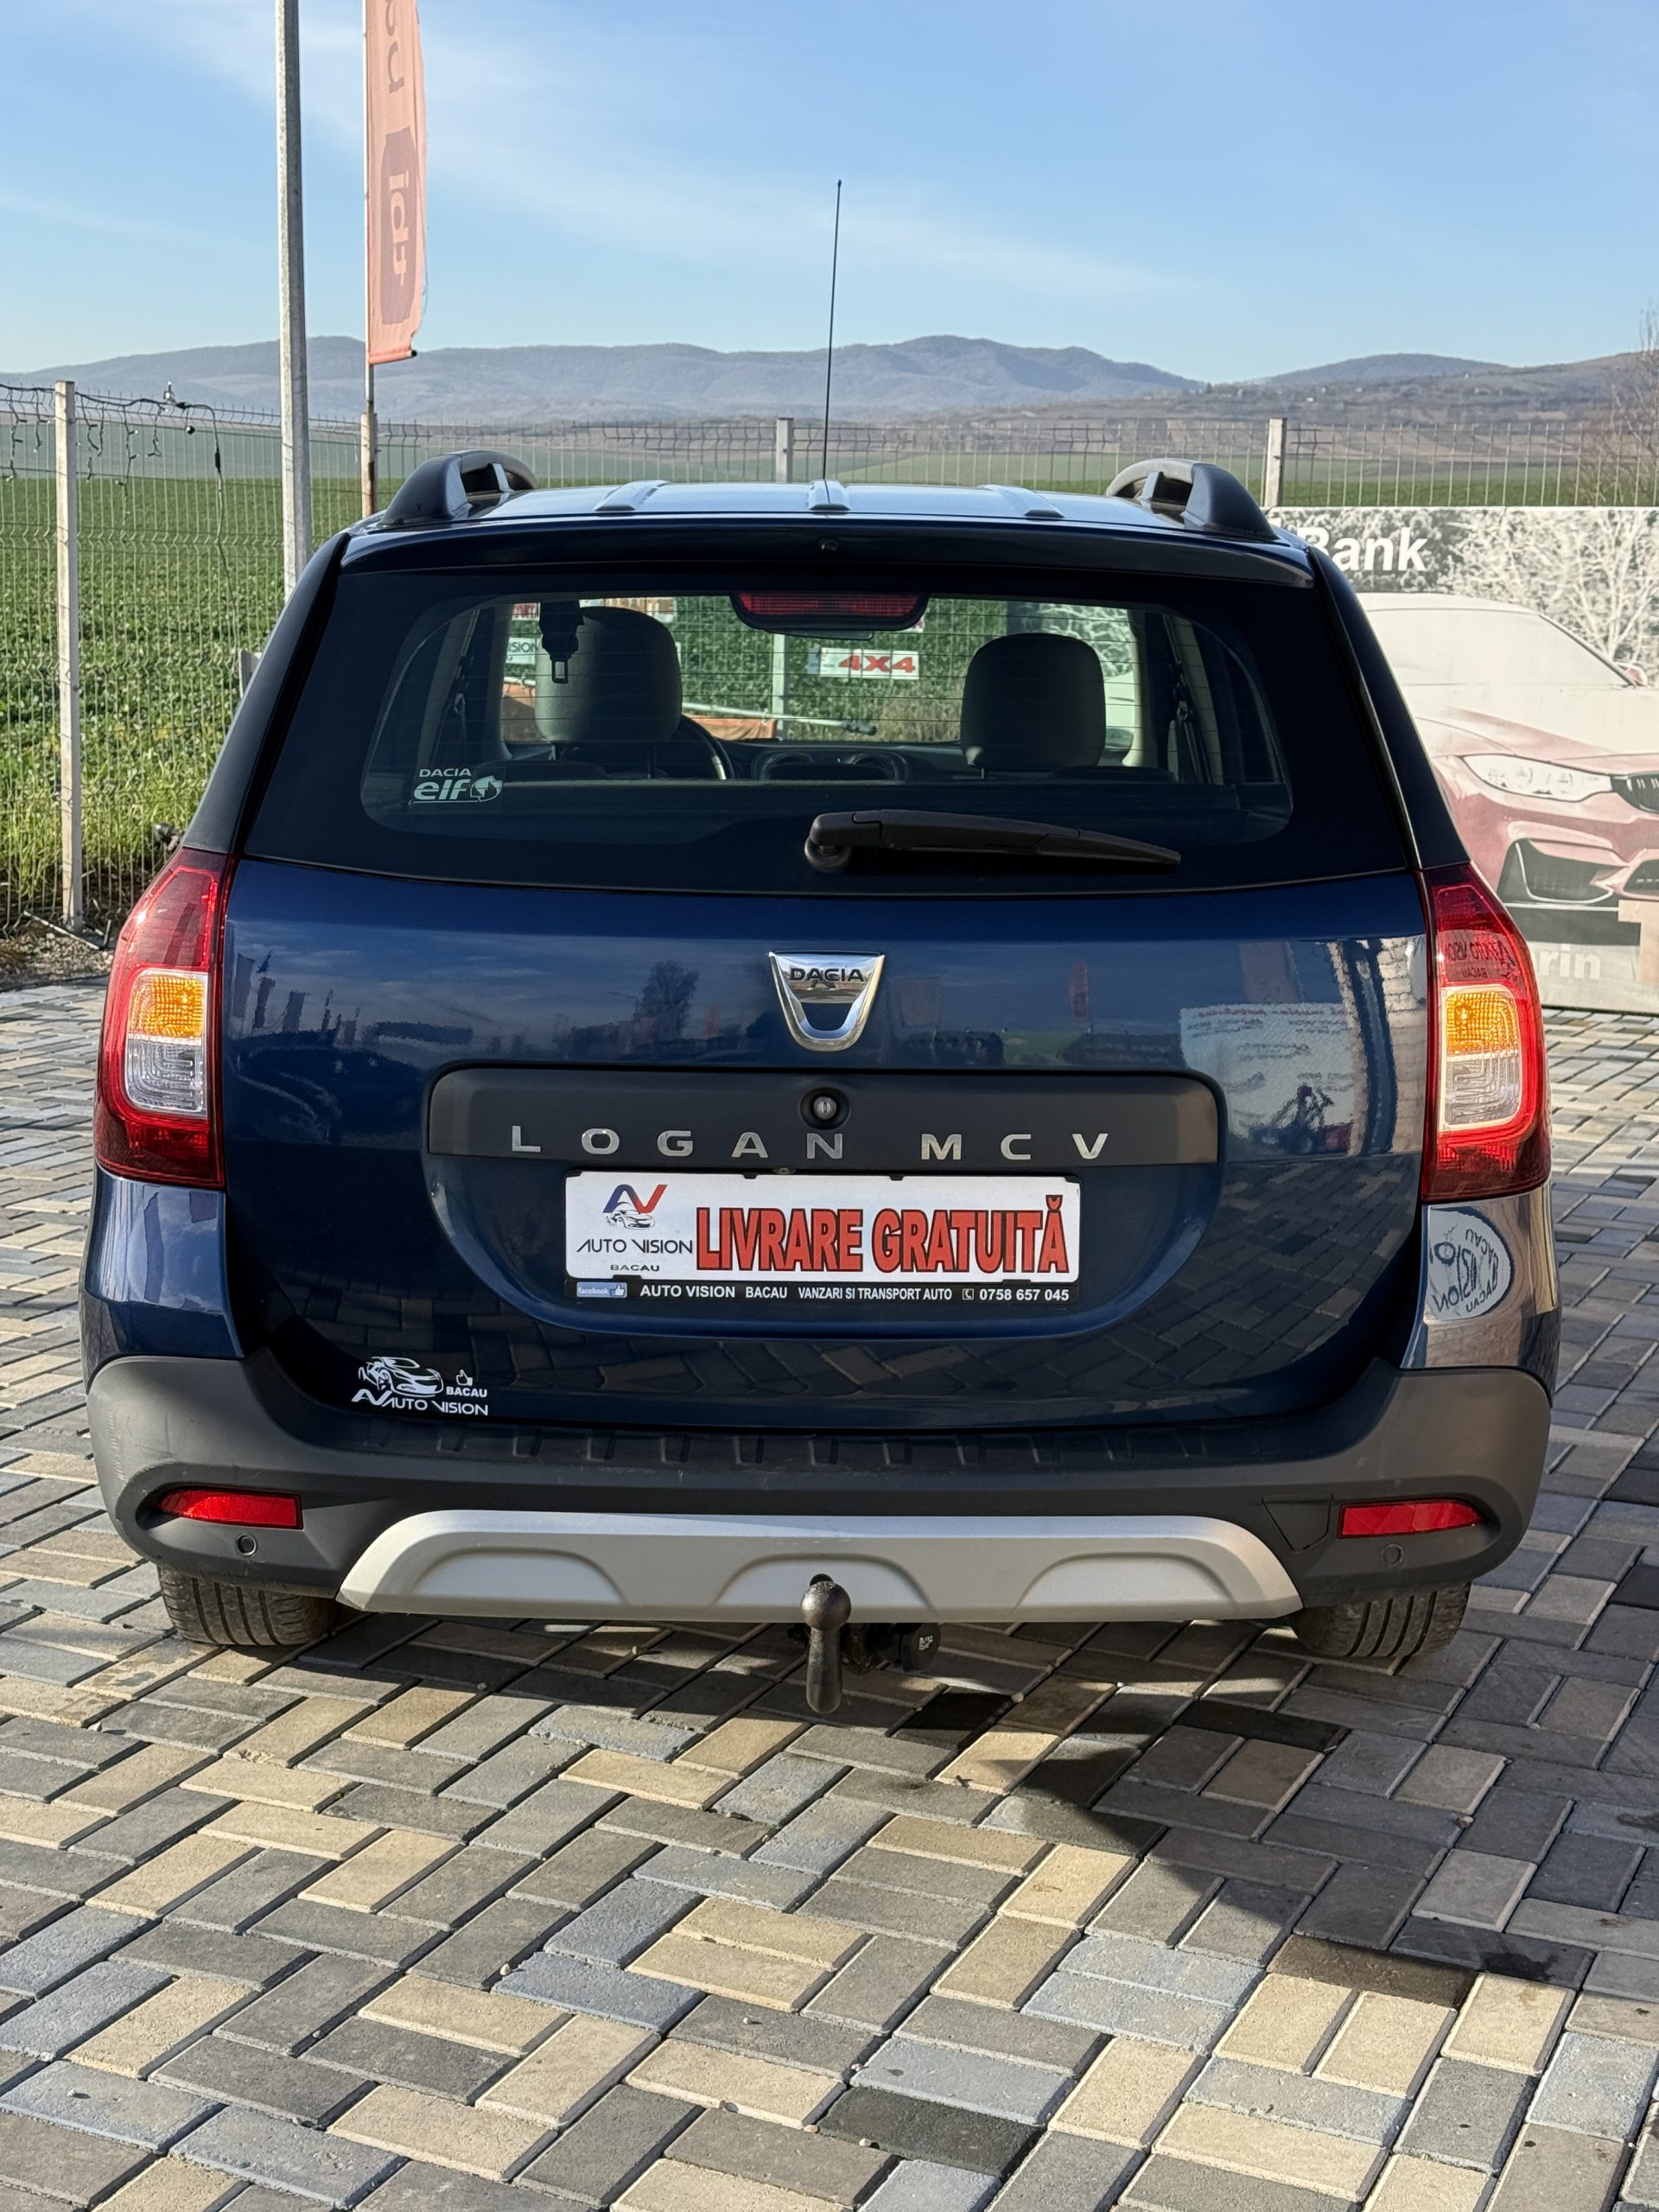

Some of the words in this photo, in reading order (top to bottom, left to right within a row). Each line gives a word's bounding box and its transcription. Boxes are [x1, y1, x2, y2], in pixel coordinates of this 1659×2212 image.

[419, 768, 472, 778] DACIA
[414, 779, 471, 800] elf
[1537, 944, 1601, 980] rin
[790, 968, 864, 982] DACIA
[512, 1126, 843, 1160] LOGAN
[921, 1133, 1109, 1160] MCV
[696, 1207, 864, 1272] LIVRARE
[872, 1194, 1070, 1274] GRATUITĂ
[576, 1238, 626, 1253] AUTO
[632, 1239, 693, 1255] VISION
[640, 1285, 682, 1297] AUTO
[686, 1286, 735, 1298] VISION
[746, 1287, 787, 1299] BACAU
[798, 1287, 843, 1300] VANZARI
[846, 1287, 855, 1300] SI
[858, 1287, 922, 1300] TRANSPORT
[923, 1288, 952, 1300] AUTO
[980, 1289, 1012, 1300] 0758
[1016, 1289, 1040, 1301] 657
[1045, 1289, 1070, 1301] 045
[446, 1386, 487, 1398] BACAU
[382, 1397, 428, 1411] AUTO
[431, 1400, 488, 1416] VISION
